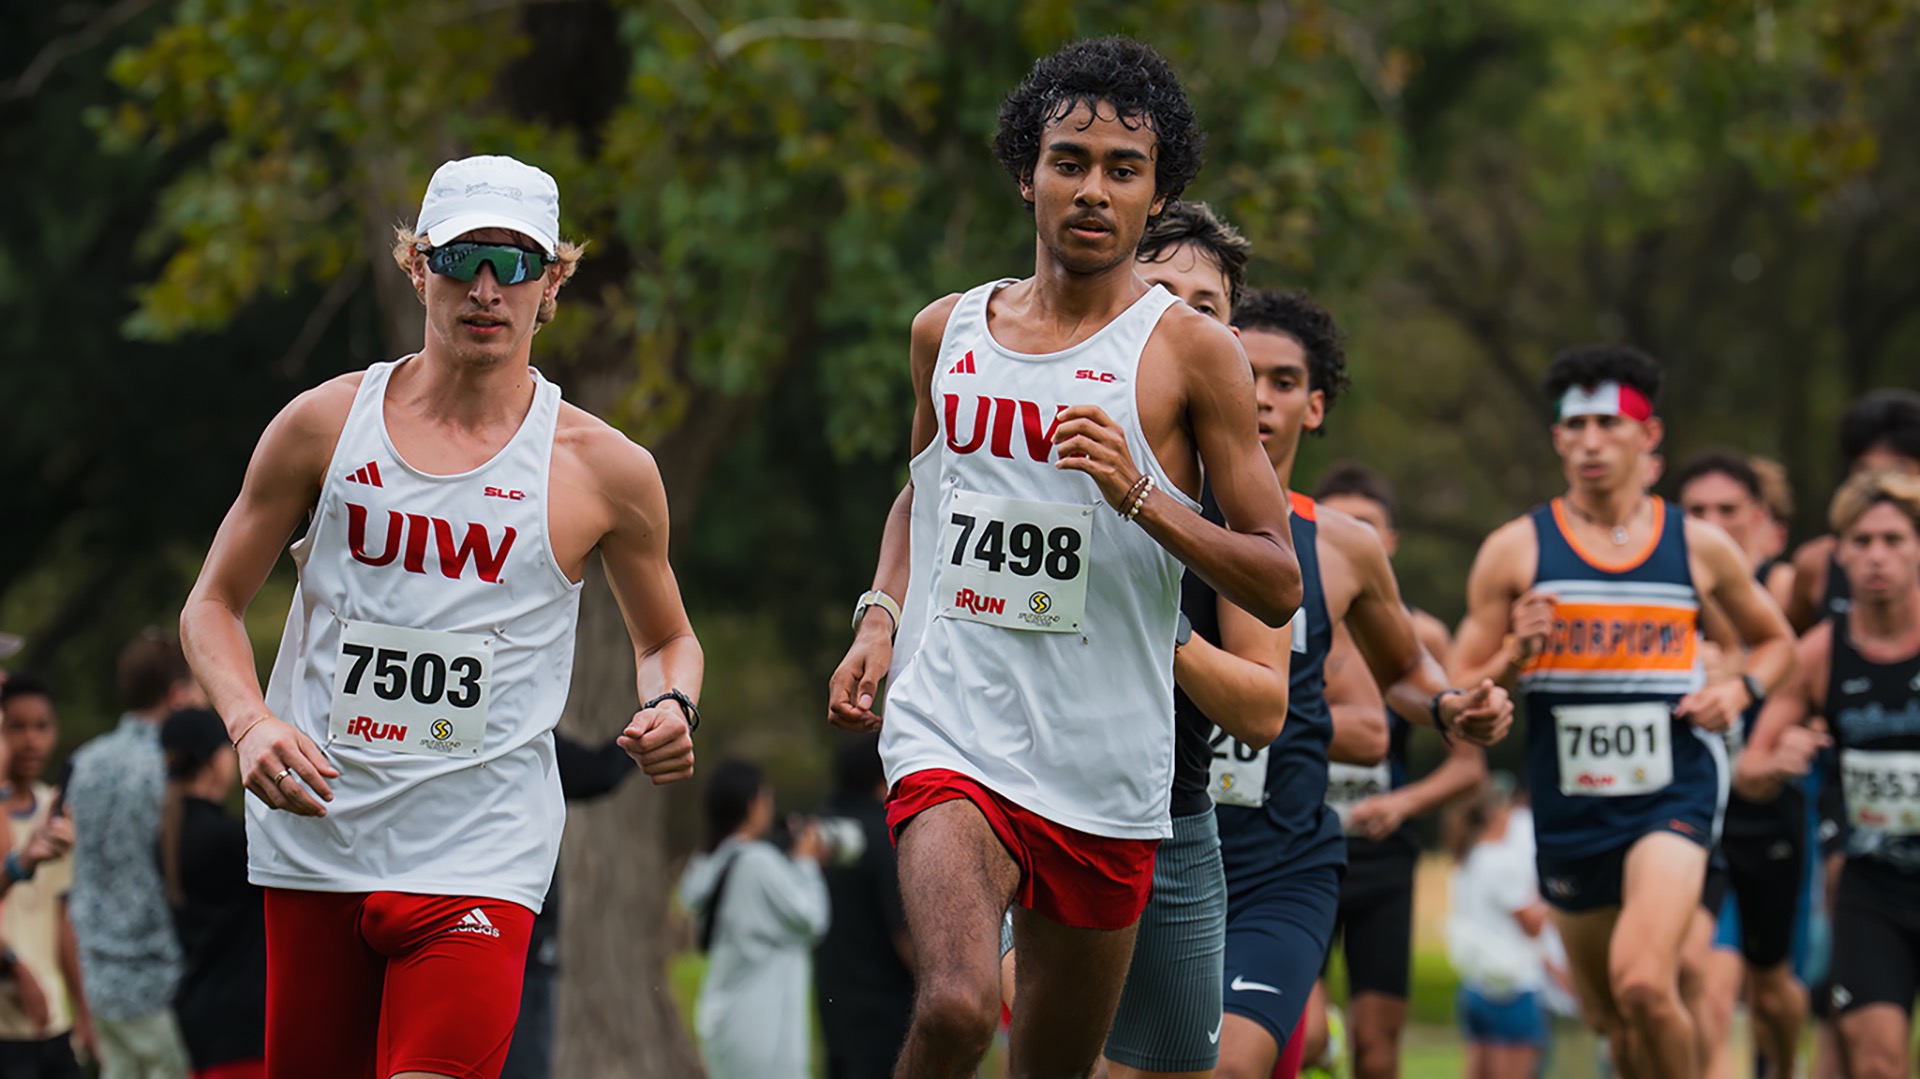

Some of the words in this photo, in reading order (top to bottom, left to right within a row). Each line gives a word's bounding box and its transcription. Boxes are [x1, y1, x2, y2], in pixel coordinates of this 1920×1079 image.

[1075, 369, 1115, 383] SLC
[483, 486, 526, 500] SLC
[345, 502, 517, 583] UIW
[951, 513, 1082, 581] 7498
[955, 588, 1006, 616] iRUN
[1547, 619, 1687, 655] CORPIONS
[342, 643, 482, 709] 7503
[347, 715, 408, 743] iRUN
[1564, 720, 1656, 758] 7601
[448, 923, 500, 938] didas
